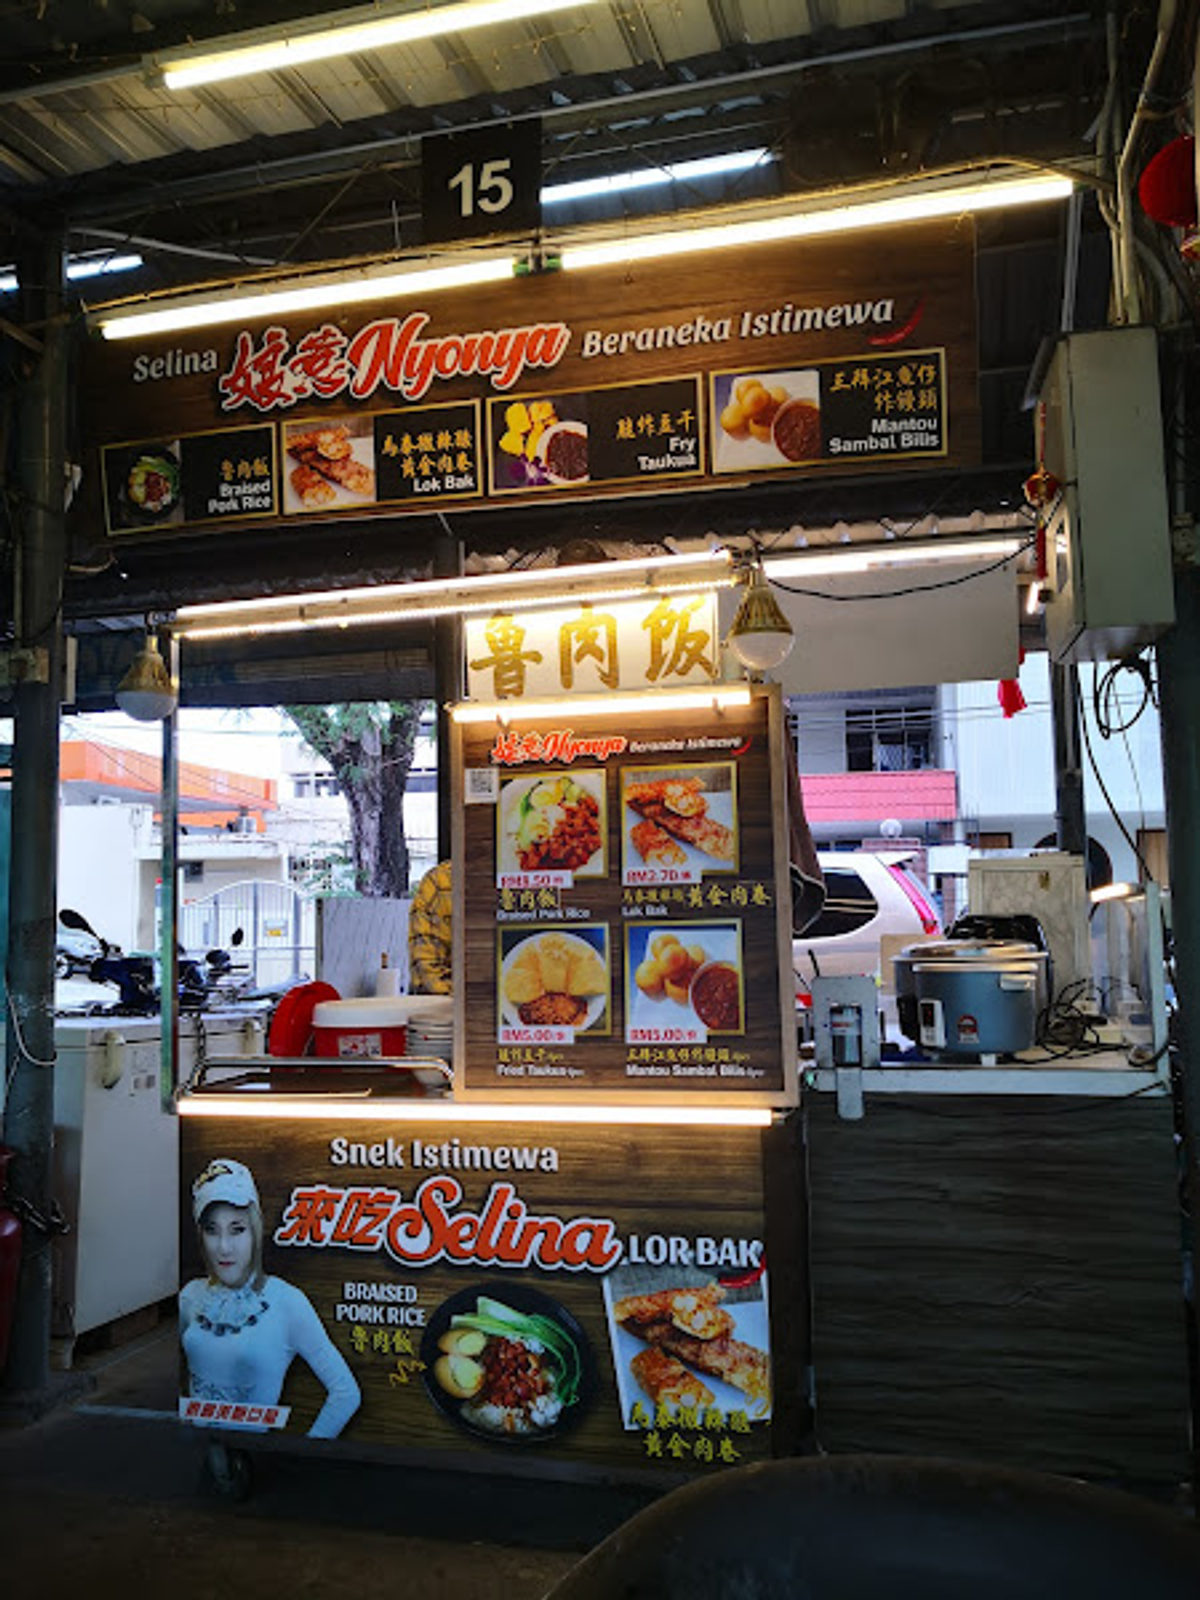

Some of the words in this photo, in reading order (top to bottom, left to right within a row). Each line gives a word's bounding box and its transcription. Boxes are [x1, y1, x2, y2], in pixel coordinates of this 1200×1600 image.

[448, 159, 513, 217] 15
[133, 349, 218, 382] Selina
[219, 324, 349, 411] 娘惹
[346, 313, 571, 400] Nyonya
[581, 315, 731, 358] Beraneka
[740, 299, 895, 339] Istimewa
[871, 418, 938, 434] Mantou
[668, 437, 697, 453] Fry
[828, 434, 898, 455] Sambal
[900, 431, 940, 449] Bilis
[219, 479, 271, 498] Braised
[413, 476, 442, 493] Lok
[444, 473, 475, 490] Bak
[207, 498, 241, 514] Pork
[242, 496, 271, 511] Rice
[469, 593, 719, 698] 魯肉飯
[542, 728, 628, 765] Nyonya
[330, 1137, 406, 1169] Snek
[412, 1138, 559, 1172] Istimewa
[274, 1185, 401, 1250] 來吃
[385, 1175, 623, 1271] Selina
[343, 1281, 417, 1303] BRAISED
[335, 1303, 385, 1324] PORK
[386, 1306, 427, 1327] RICE
[350, 1325, 413, 1355] 魯肉飯
